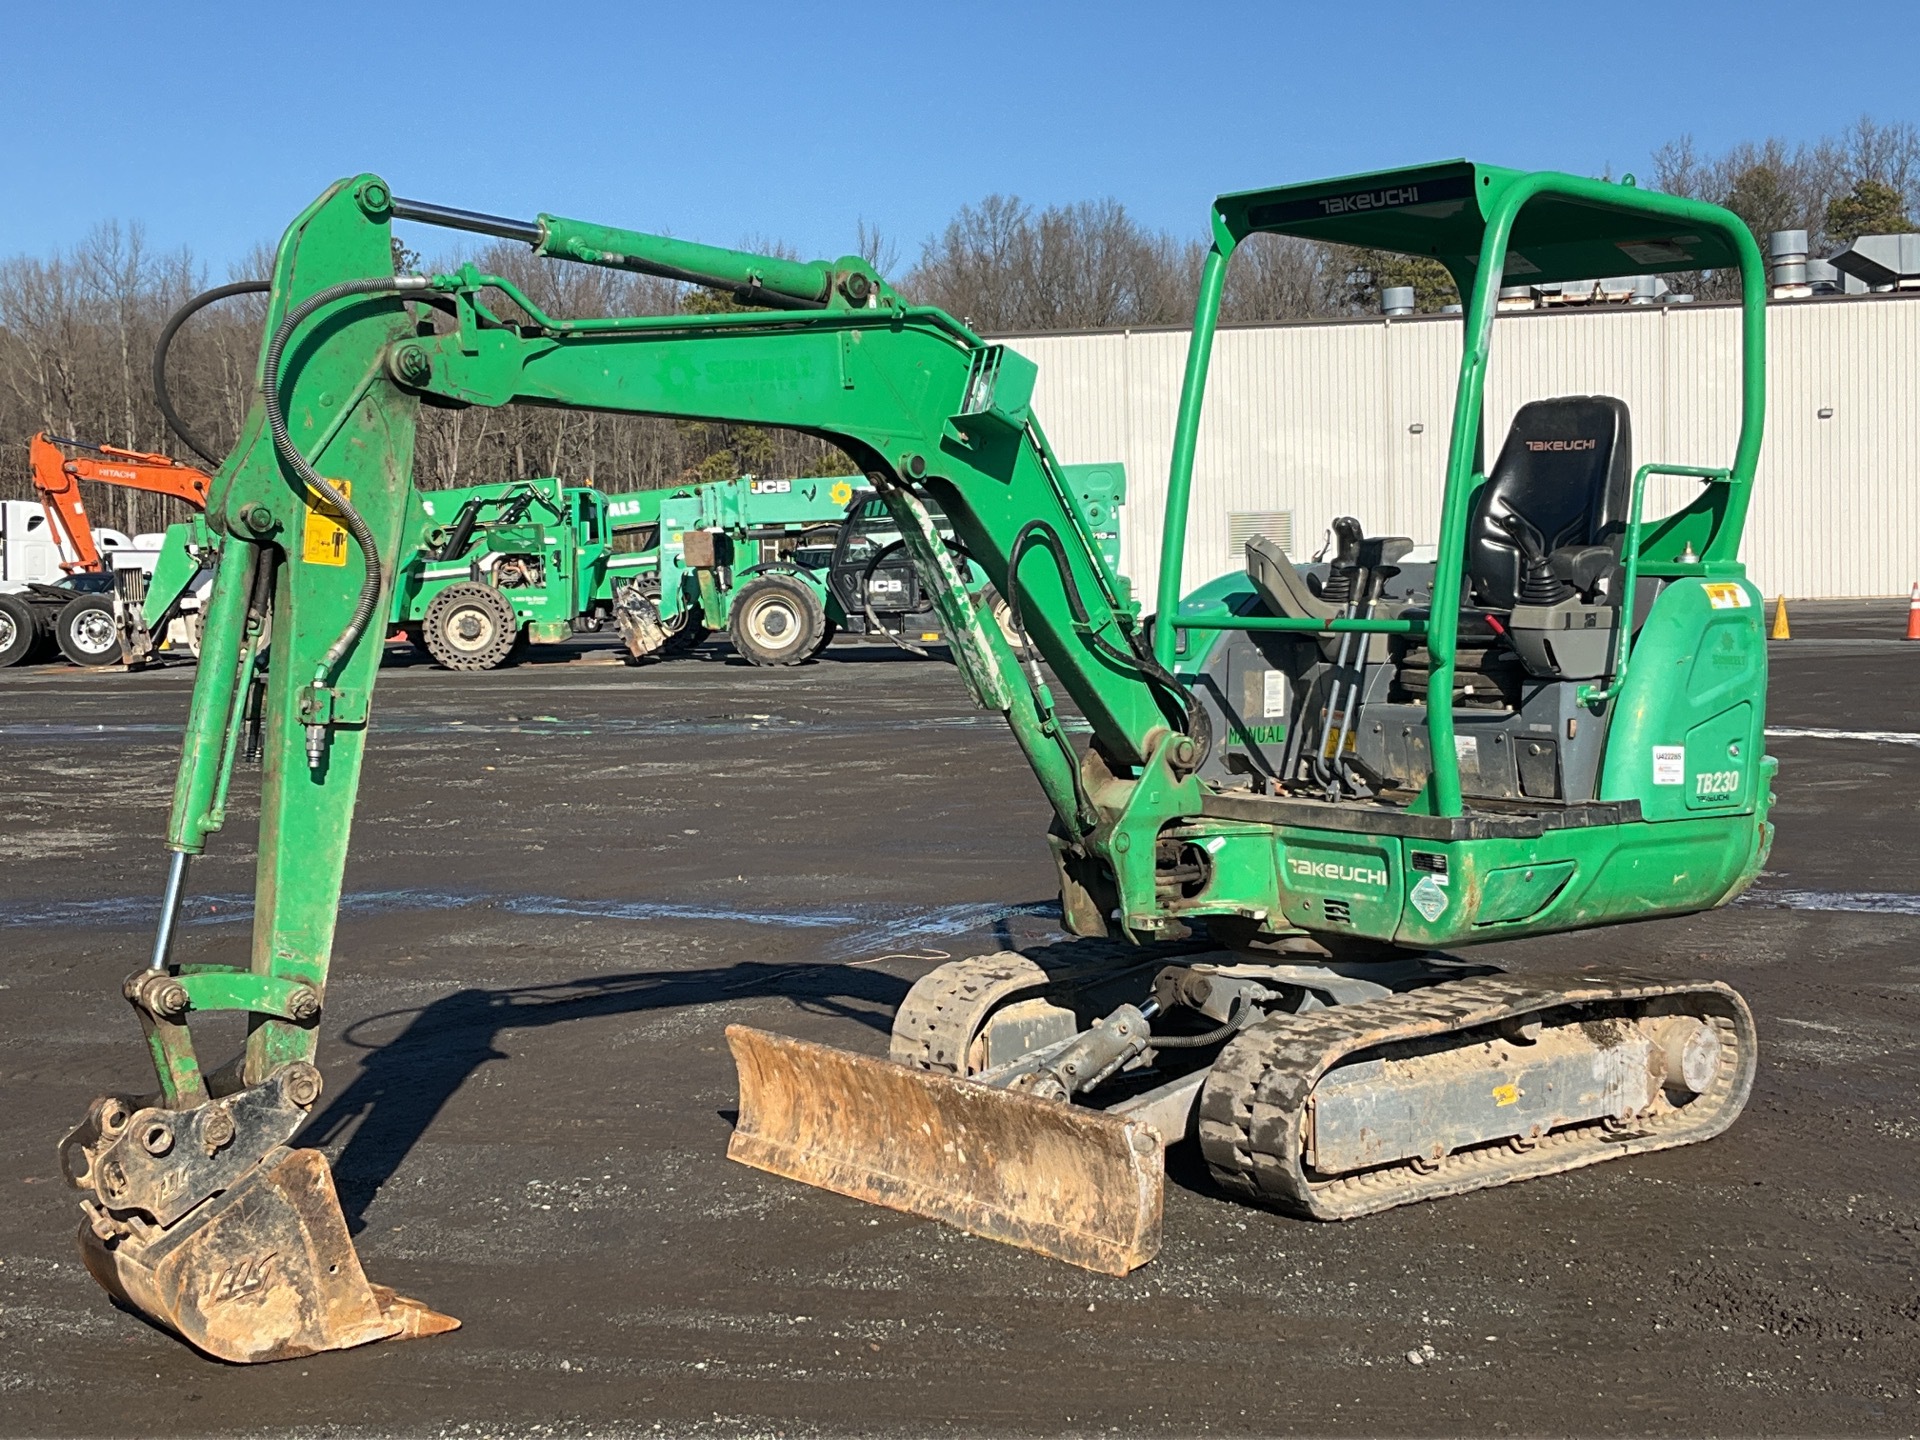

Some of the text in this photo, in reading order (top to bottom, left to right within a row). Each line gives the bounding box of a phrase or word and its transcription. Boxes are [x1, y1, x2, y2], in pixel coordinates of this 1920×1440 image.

[1318, 186, 1419, 214] TAKEUCHI
[1525, 439, 1596, 451] TAKEUCHI
[99, 468, 136, 479] HITACHI
[751, 480, 791, 495] JCB
[1228, 725, 1285, 745] MANUAL
[1696, 770, 1740, 795] TB230
[1287, 858, 1388, 886] TAKEUCHI
